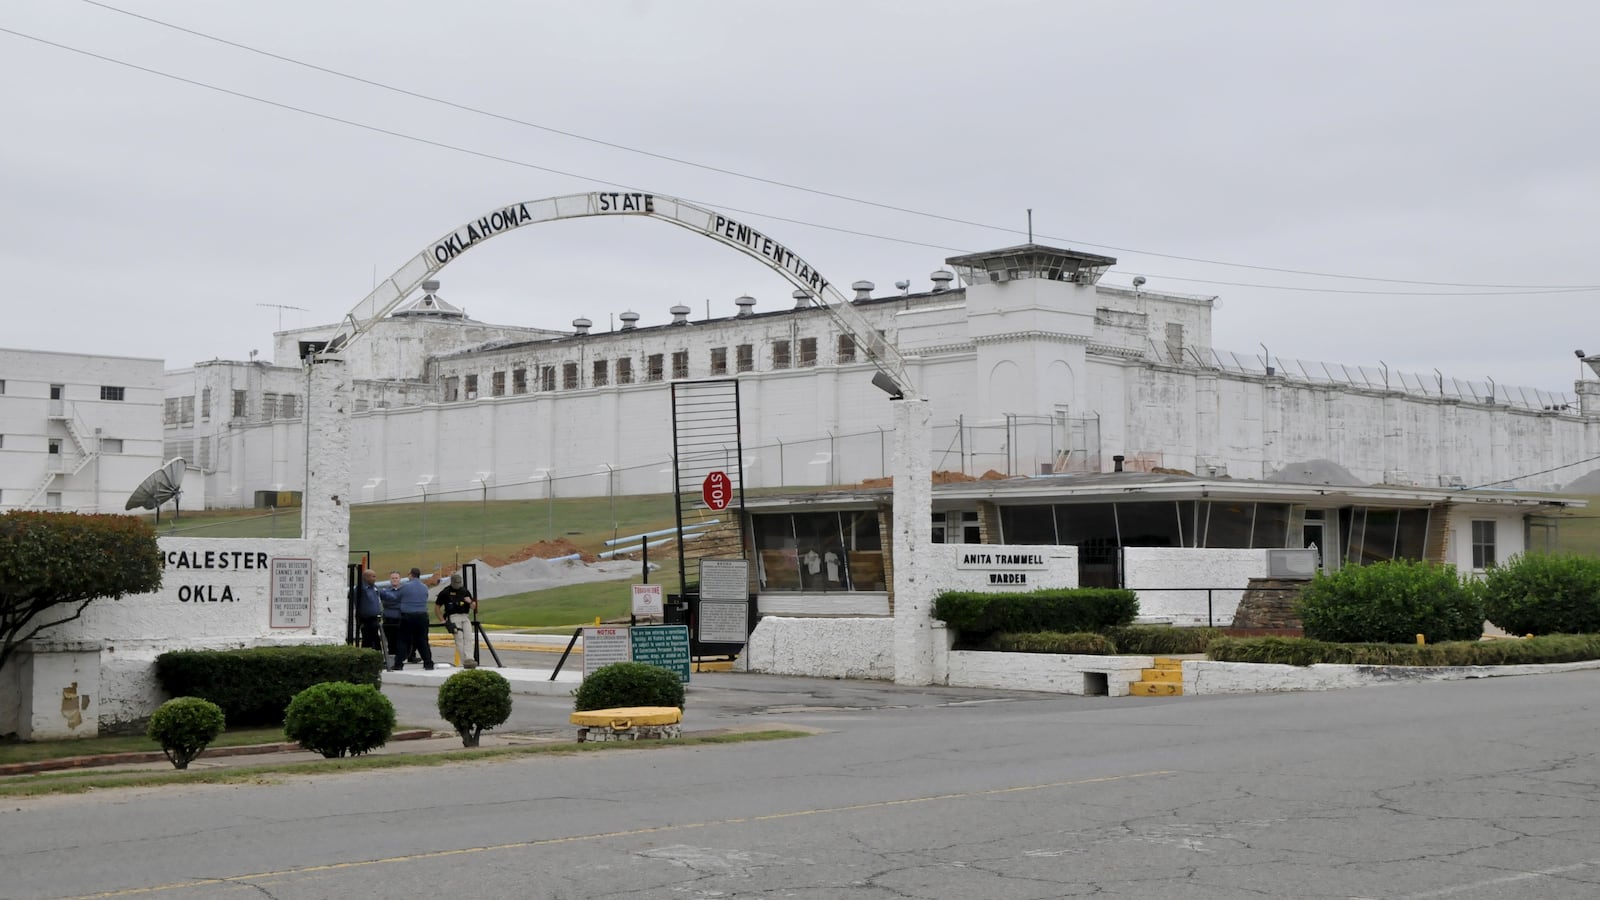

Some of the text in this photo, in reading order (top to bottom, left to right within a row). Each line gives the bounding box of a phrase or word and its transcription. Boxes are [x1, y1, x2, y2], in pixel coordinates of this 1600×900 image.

[435, 193, 829, 294] OKLAHOMA STATE PENITENTIARY
[711, 474, 724, 508] STOP
[963, 554, 1044, 564] ANITA TRAMMELL
[989, 573, 1026, 583] WARDEN
[178, 585, 240, 602] OKLA.
